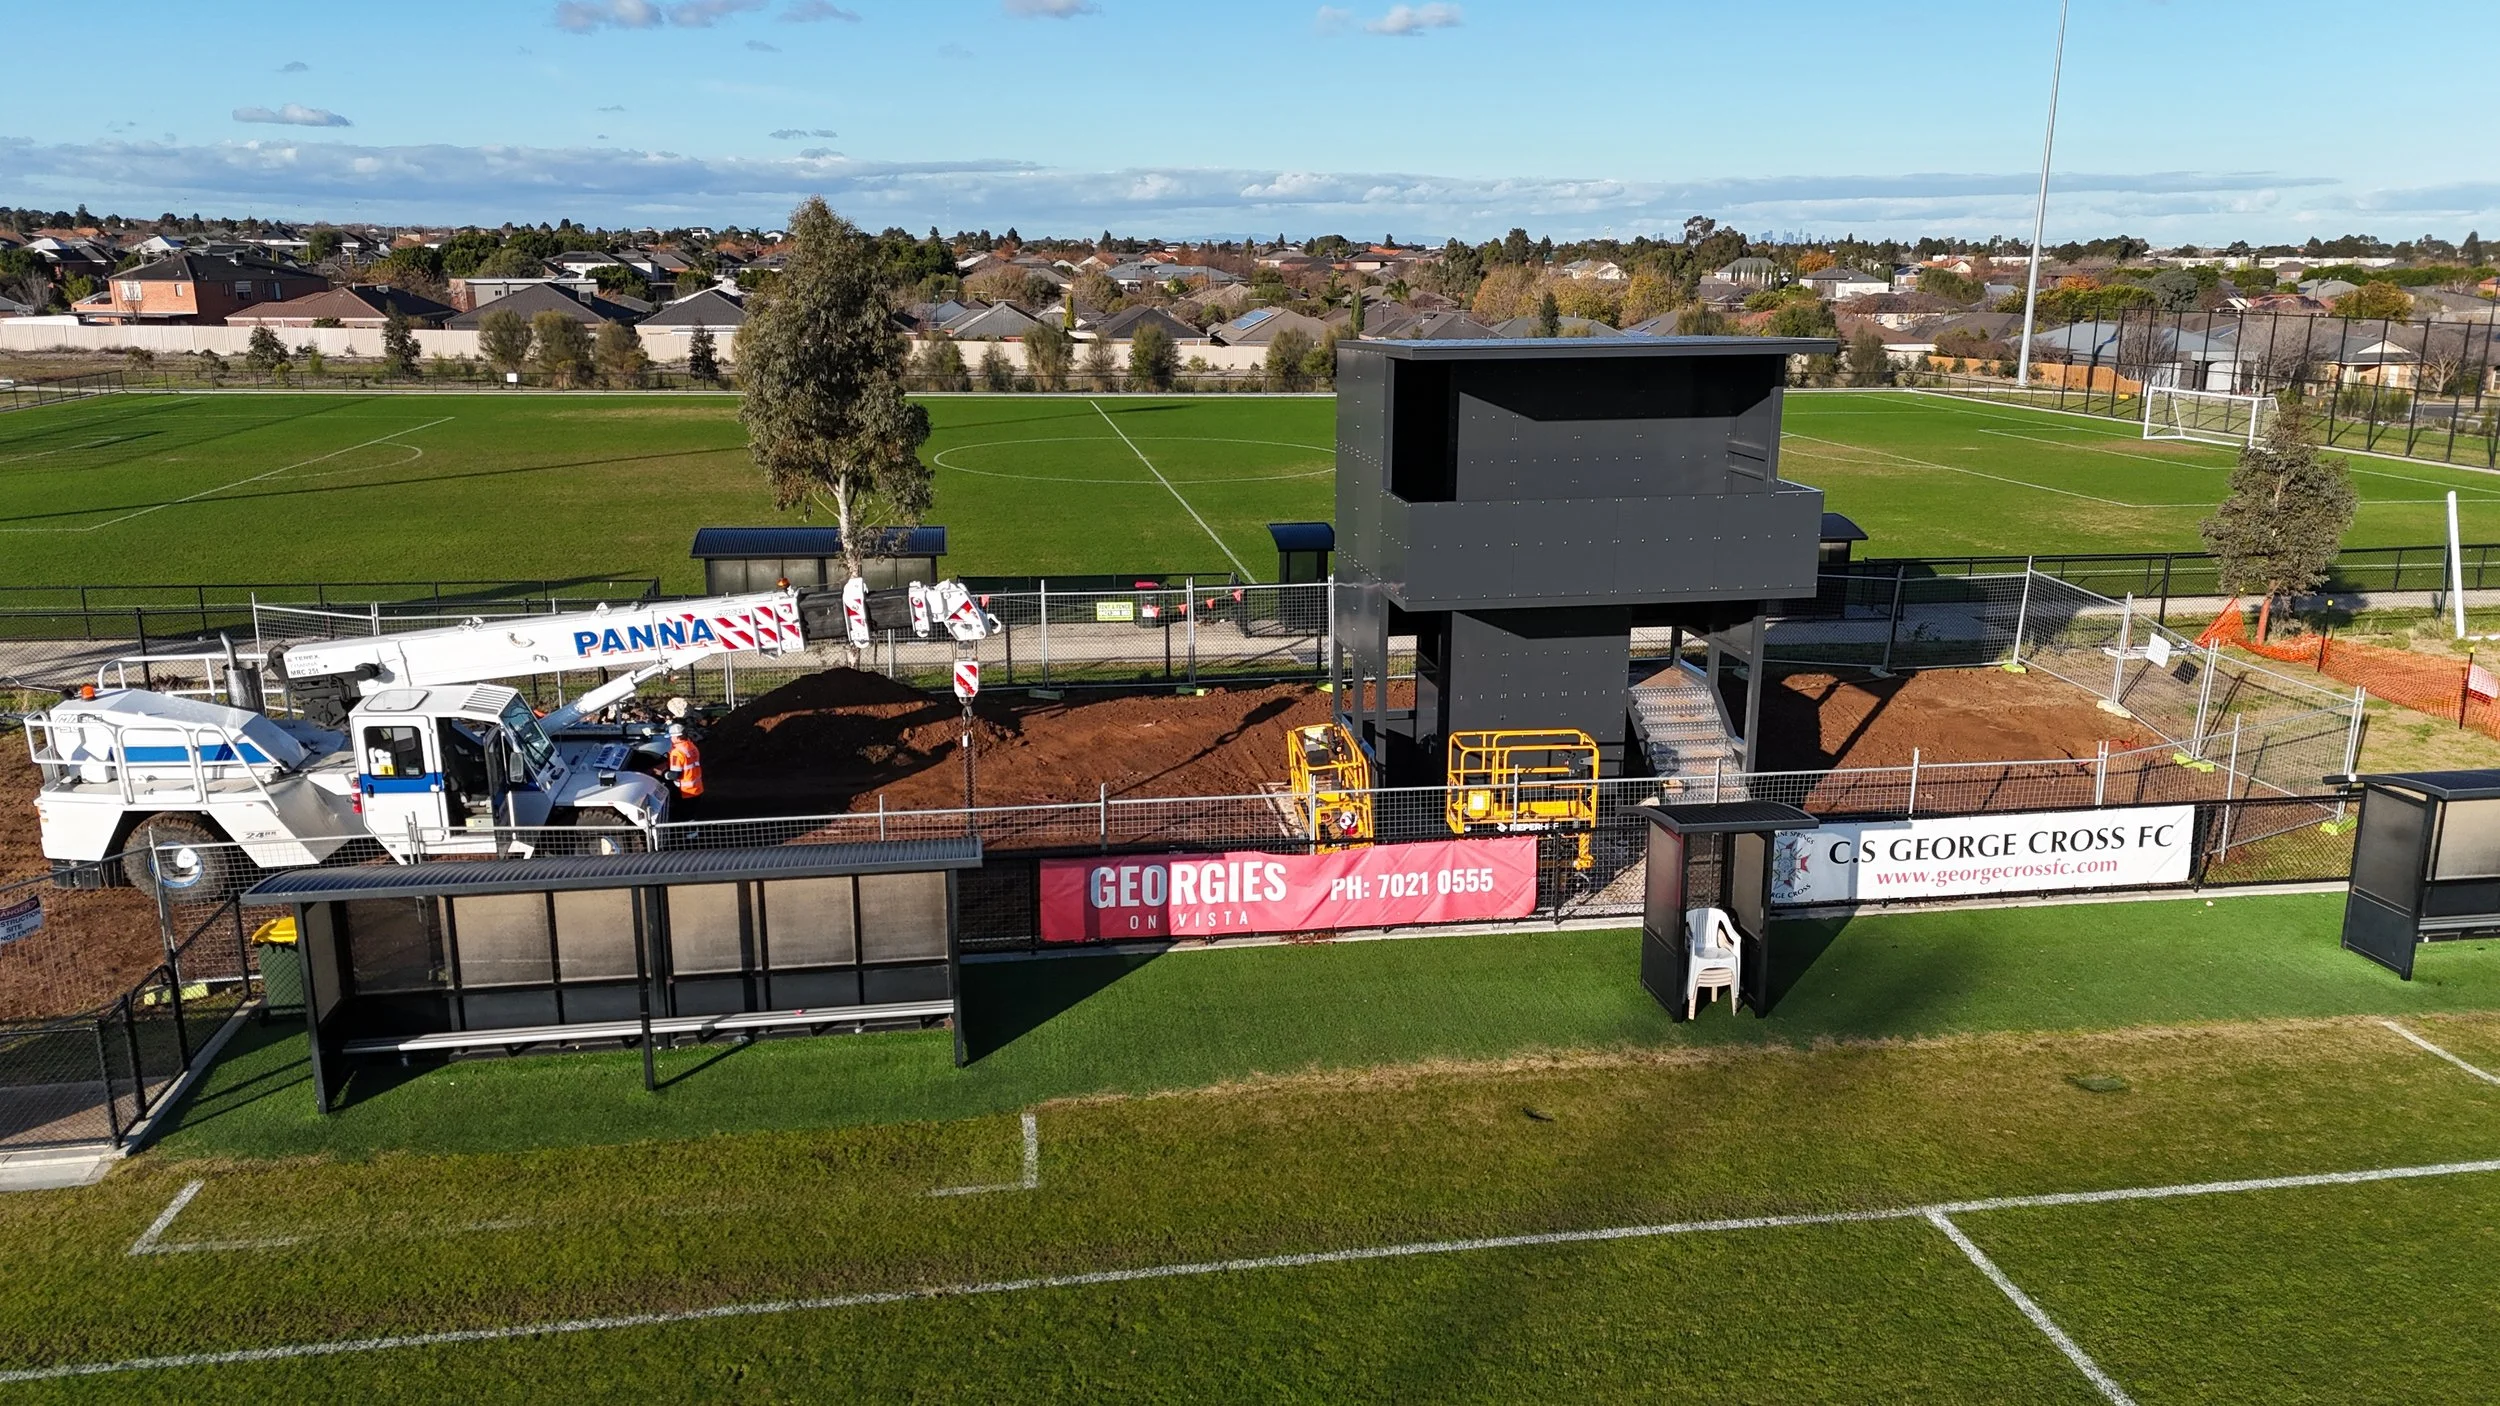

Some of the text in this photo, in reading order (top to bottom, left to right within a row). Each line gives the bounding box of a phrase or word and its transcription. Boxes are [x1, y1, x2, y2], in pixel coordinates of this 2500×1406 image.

[573, 618, 720, 658] PANNA
[1790, 831, 1814, 845] SPRINGS
[1829, 825, 2174, 864] C.S GEORGE CROSS FC
[1090, 861, 1287, 909] GEORGIES
[1330, 868, 1494, 901] PH: 7021 0555
[1876, 858, 2118, 888] www.georgecrossfc.com
[1787, 883, 1811, 899] CROSS
[6, 923, 22, 934] SITE
[1129, 910, 1248, 930] ON VISTA
